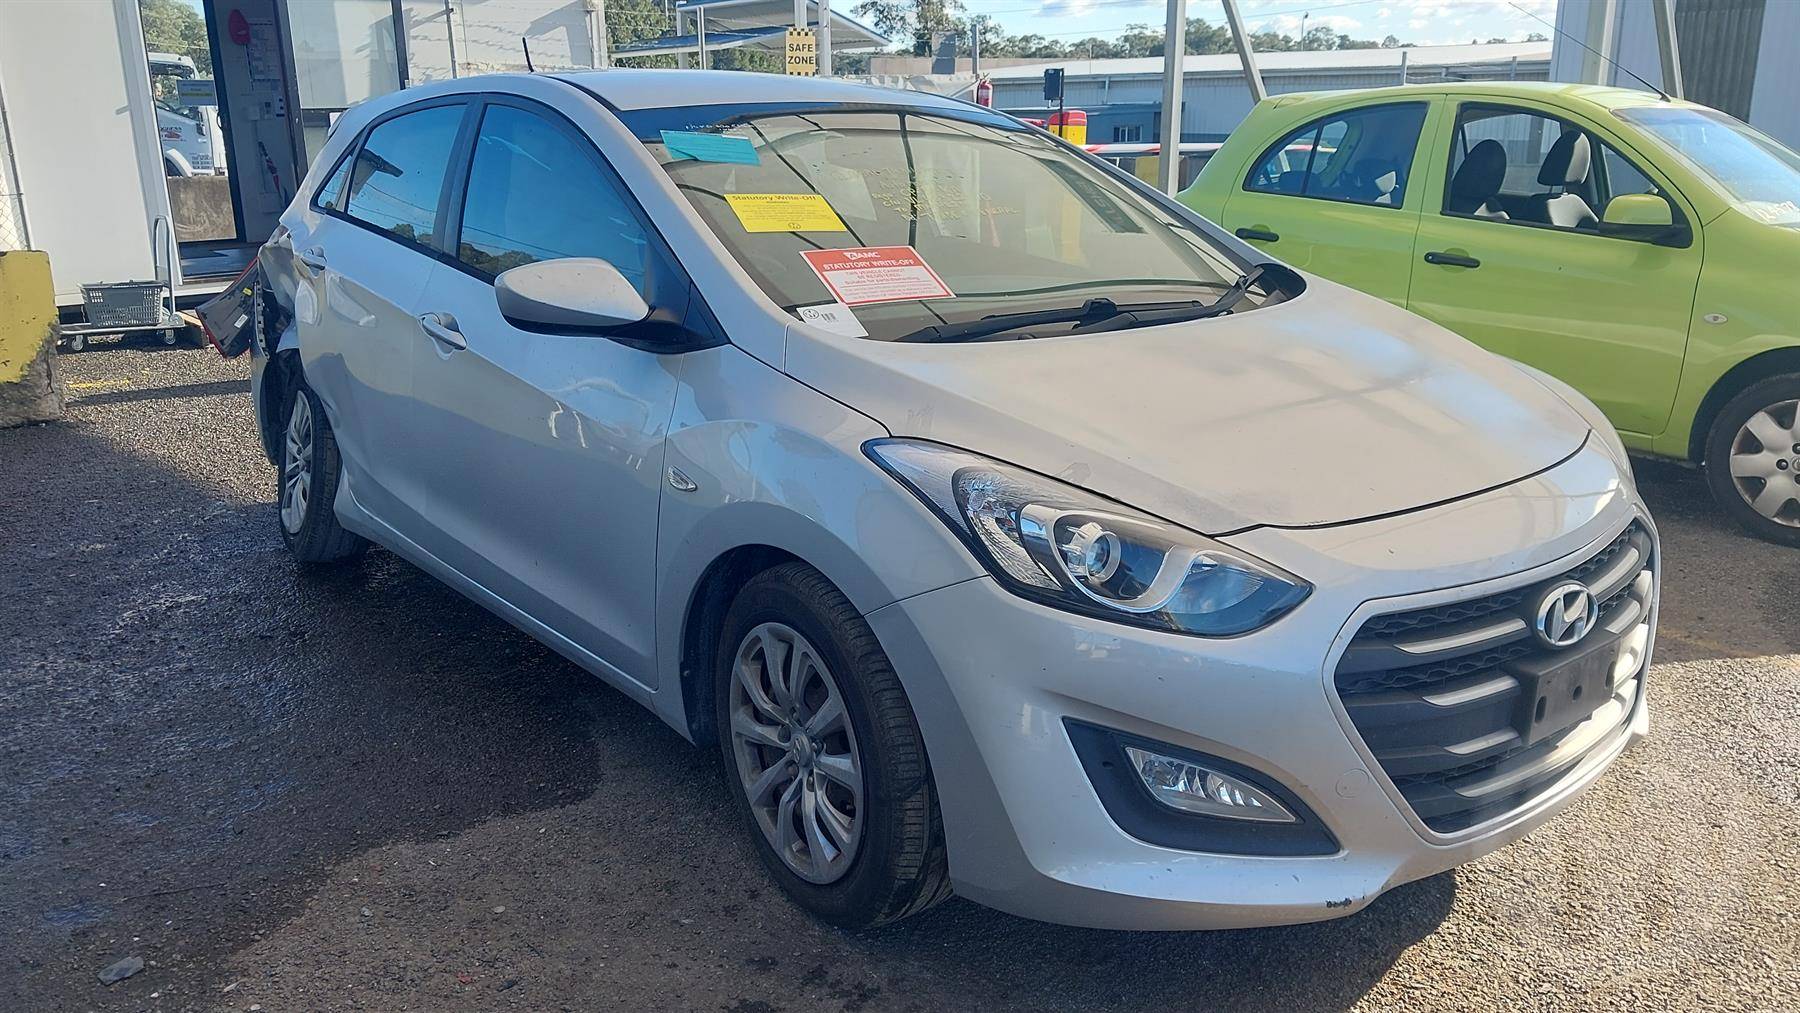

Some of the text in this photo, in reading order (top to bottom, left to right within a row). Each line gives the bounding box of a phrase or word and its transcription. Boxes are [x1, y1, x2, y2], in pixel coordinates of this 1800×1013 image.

[788, 43, 813, 52] SAFE
[787, 56, 814, 64] ZONE
[823, 259, 914, 270] STATUTORY WRITE-OFF
